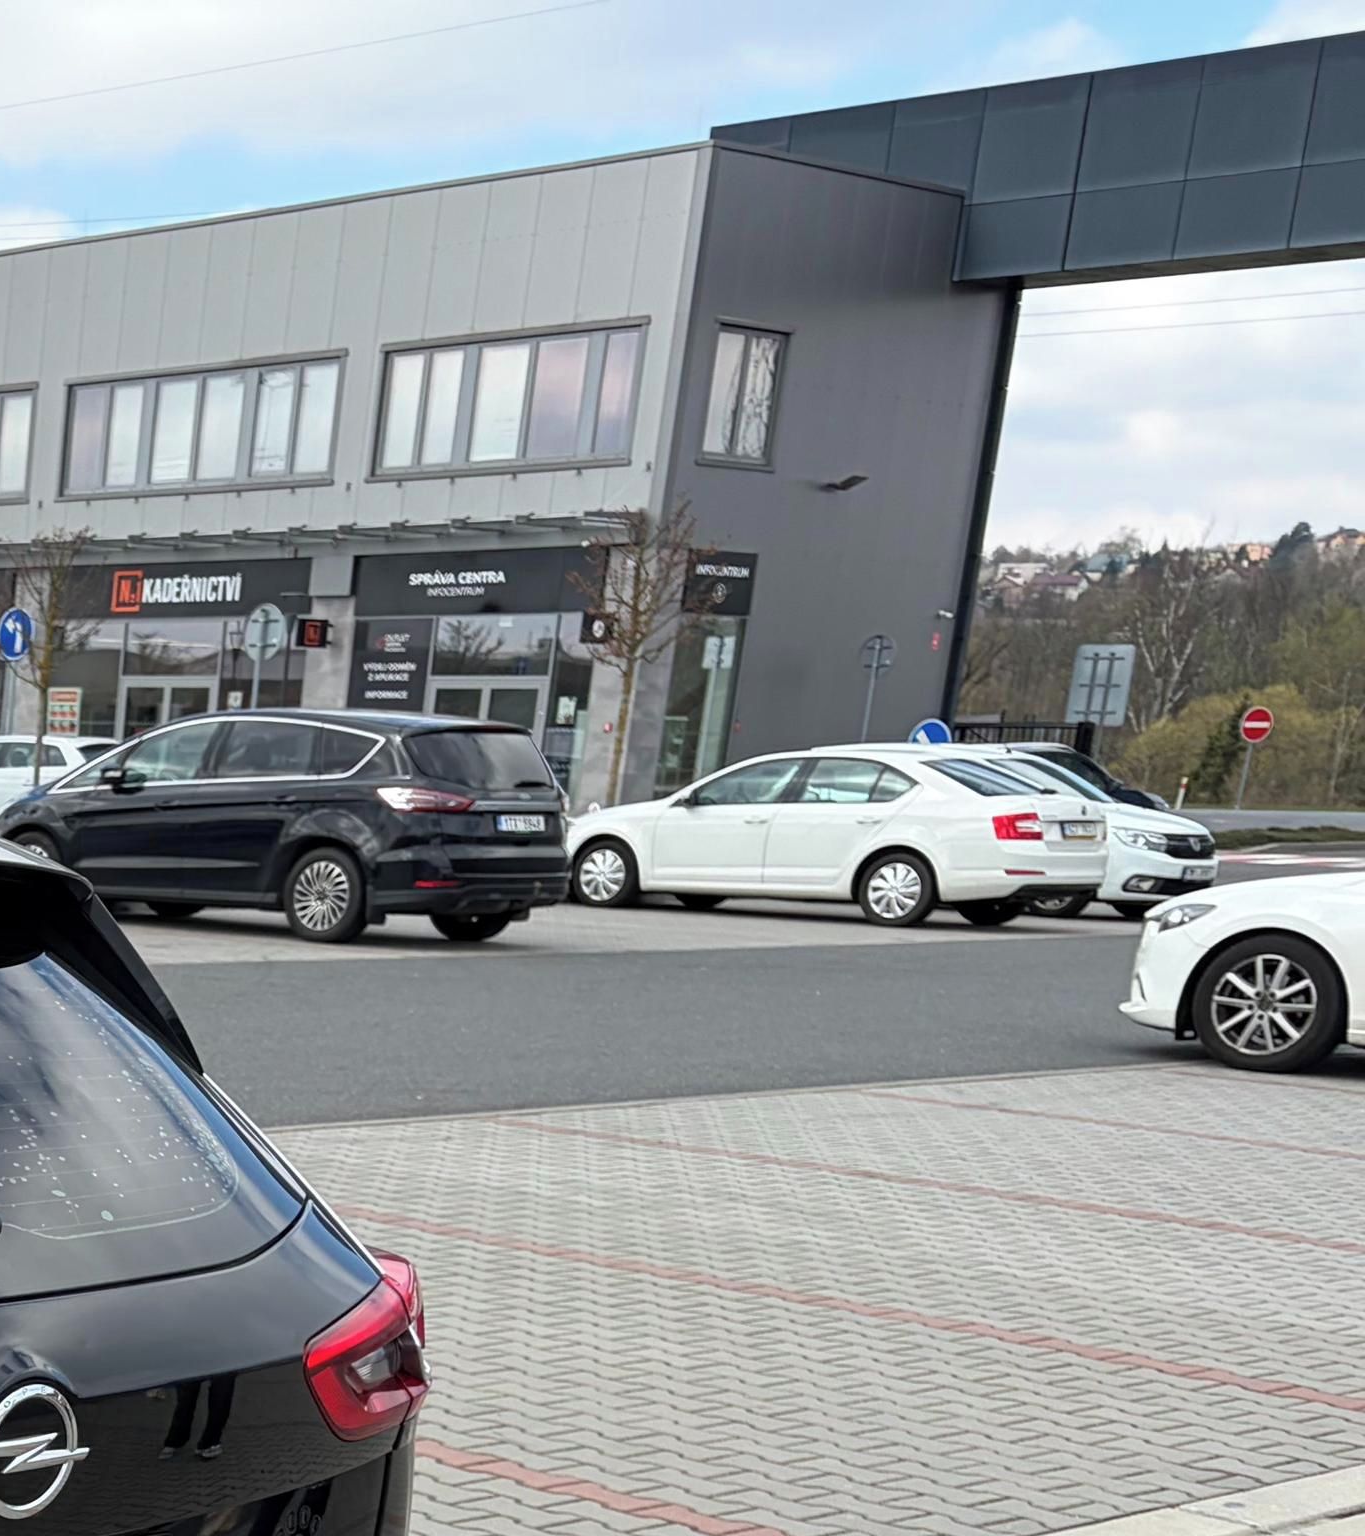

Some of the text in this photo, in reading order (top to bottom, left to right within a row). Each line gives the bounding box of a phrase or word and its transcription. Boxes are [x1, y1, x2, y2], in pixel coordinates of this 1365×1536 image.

[142, 571, 242, 603] KADEŘNICTVÍ
[409, 569, 506, 585] SPRÁVA CENTRA
